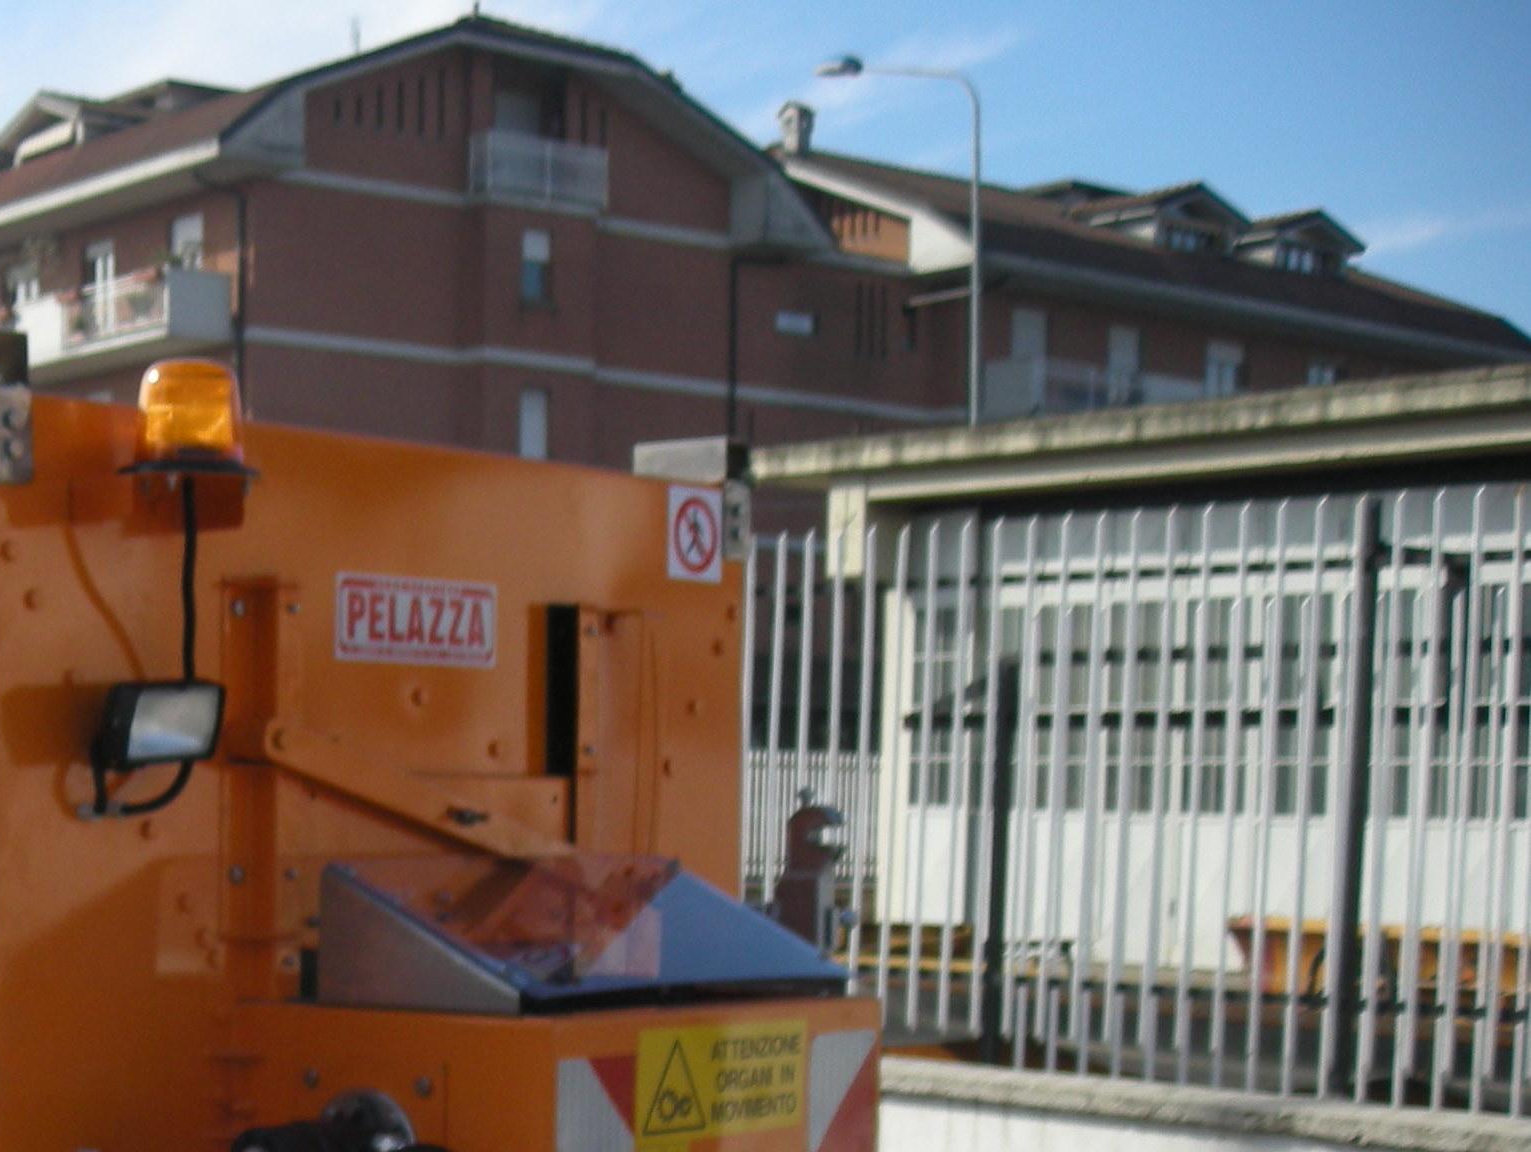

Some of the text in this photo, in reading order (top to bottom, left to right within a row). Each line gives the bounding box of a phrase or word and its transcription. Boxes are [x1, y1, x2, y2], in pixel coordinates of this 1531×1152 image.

[347, 591, 487, 648] PELAZZA
[710, 1034, 801, 1061] ATTENZIONE
[716, 1063, 796, 1093] ORGANI IN
[710, 1094, 797, 1123] MOVIMENTO
